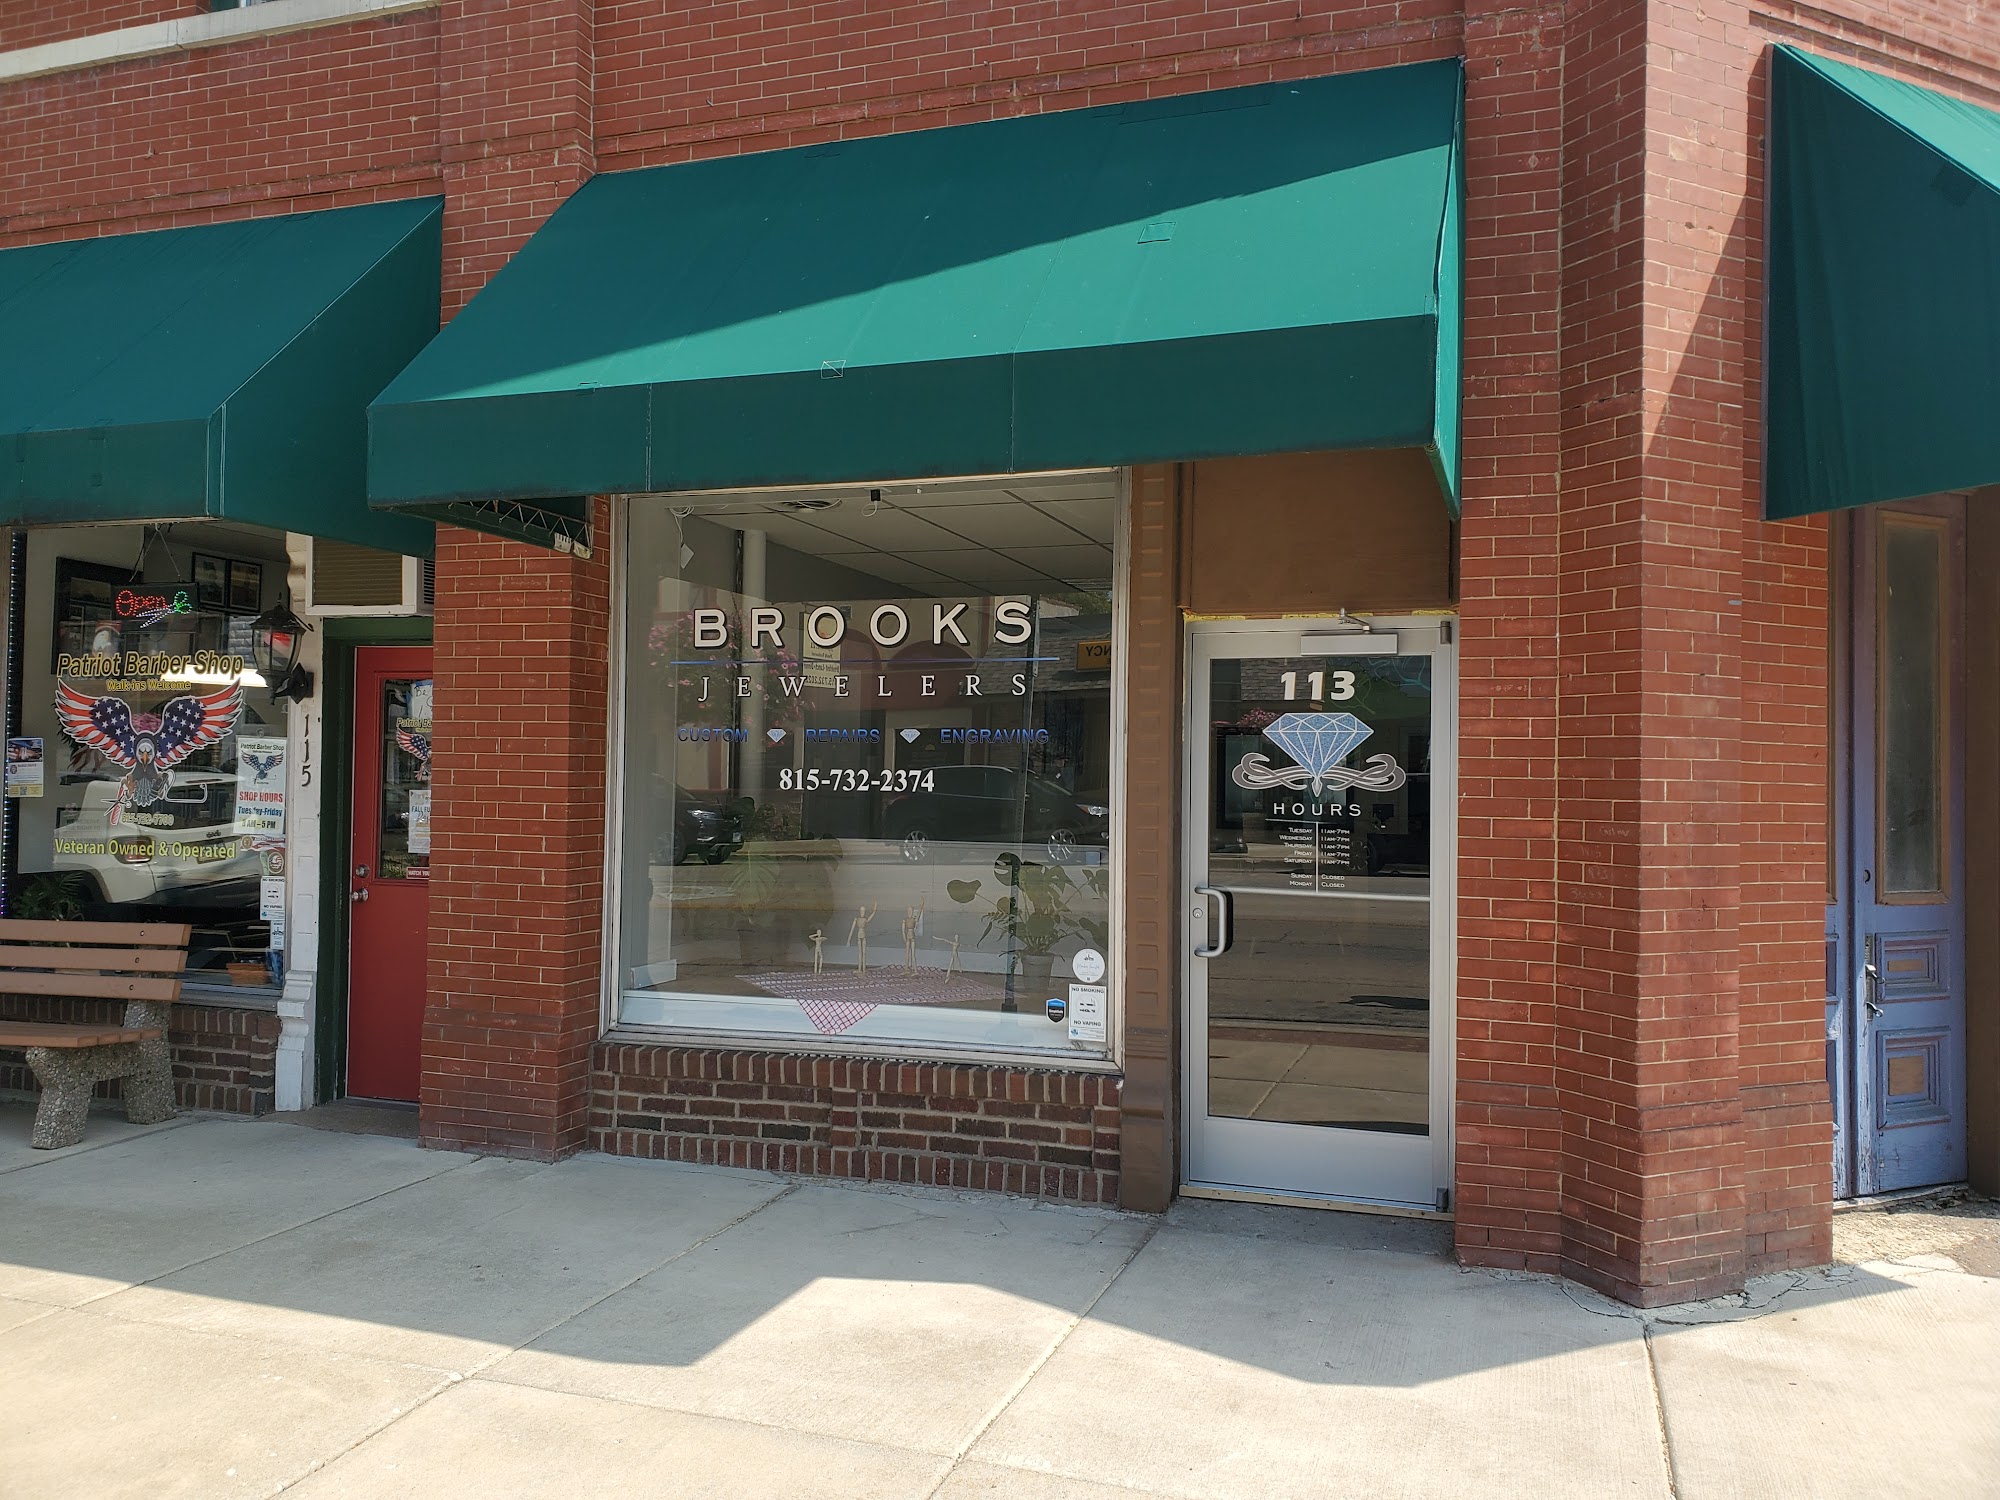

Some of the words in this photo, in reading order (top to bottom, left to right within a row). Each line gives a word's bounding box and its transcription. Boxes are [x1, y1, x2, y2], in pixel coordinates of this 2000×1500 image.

[116, 589, 168, 616] Open
[693, 601, 1034, 650] BROOKS
[57, 651, 122, 678] Patriot
[124, 650, 191, 676] Barber
[193, 649, 245, 680] Shop
[106, 679, 146, 692] Walk-ins
[147, 679, 192, 691] Welcome
[697, 673, 1027, 702] JEWELERS
[1280, 671, 1356, 701] 113
[396, 717, 421, 728] Patriot
[677, 728, 749, 744] CUSTOM
[805, 728, 881, 744] REPAIRS
[940, 728, 1050, 745] ENGRAVING
[778, 768, 936, 793] 815-732-2374
[239, 791, 259, 801] SHOP
[260, 791, 284, 803] HOURS
[1273, 802, 1361, 817] HOURS
[261, 820, 266, 828] 5
[266, 820, 276, 829] PM
[55, 838, 105, 855] Veteran
[108, 839, 155, 856] Owned
[158, 841, 169, 857] &
[171, 841, 237, 861] Operated
